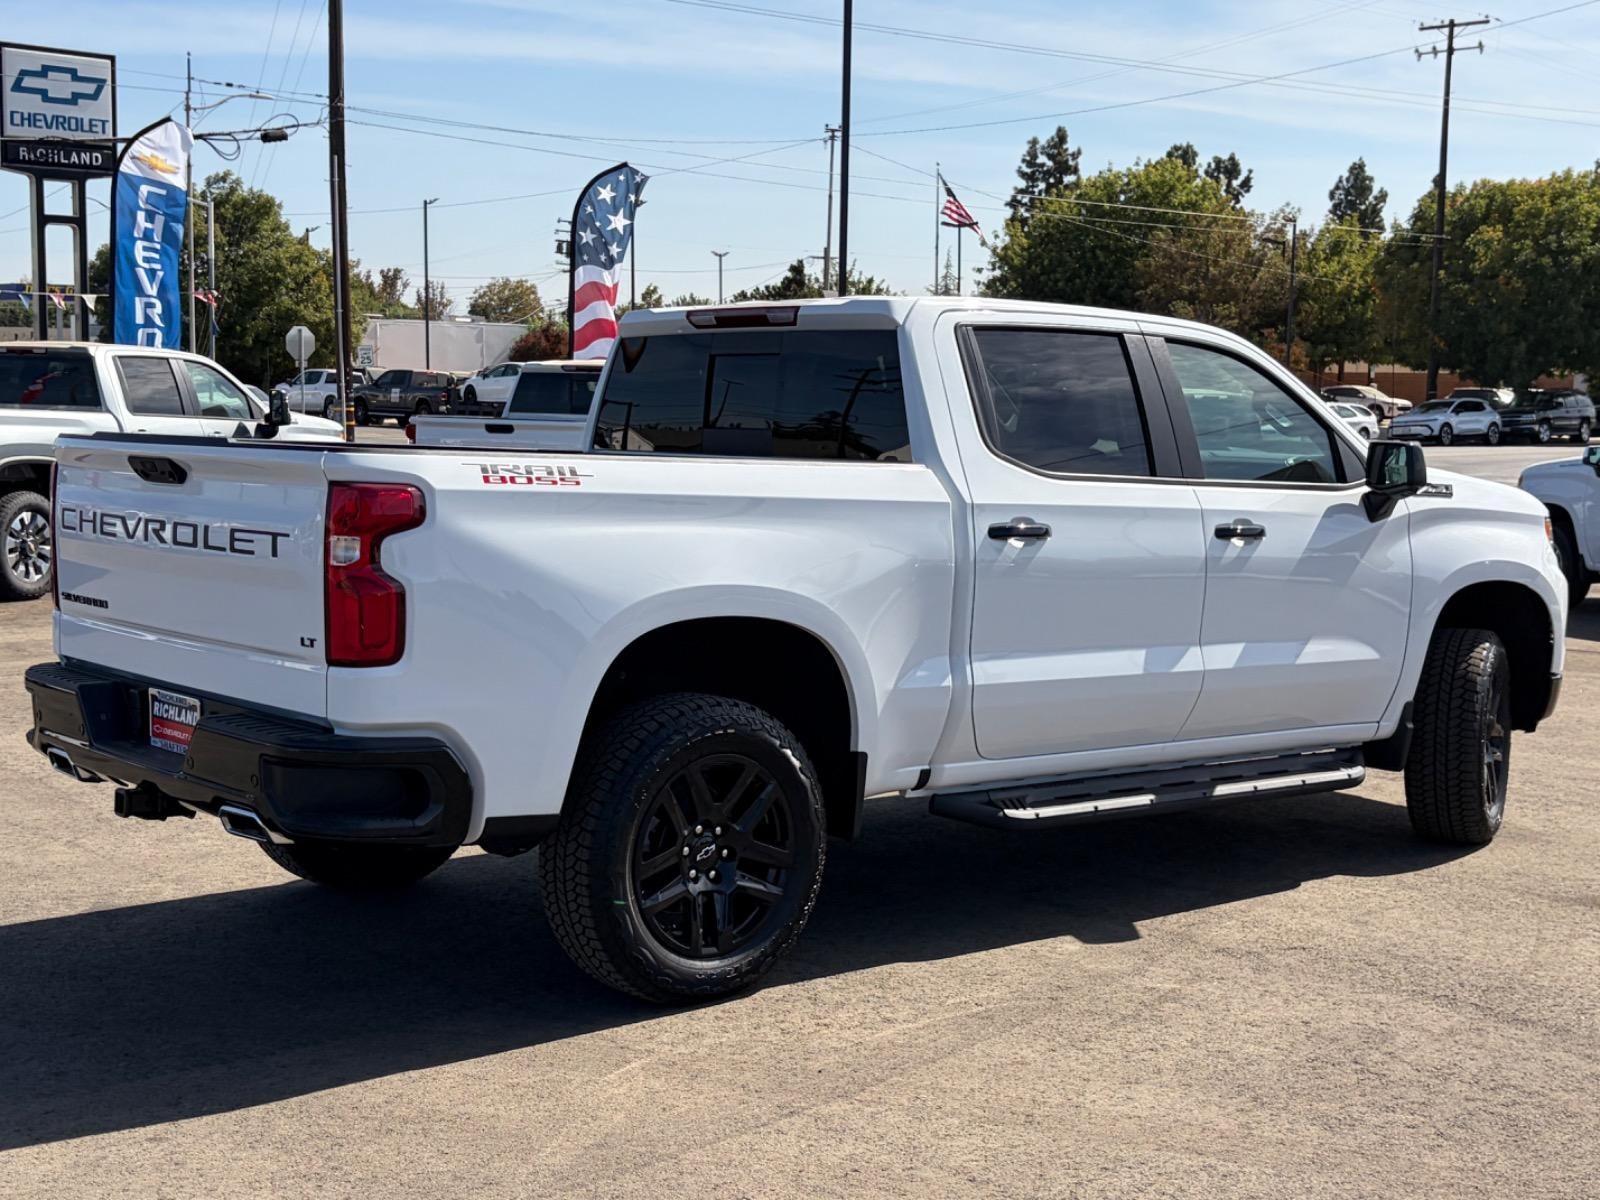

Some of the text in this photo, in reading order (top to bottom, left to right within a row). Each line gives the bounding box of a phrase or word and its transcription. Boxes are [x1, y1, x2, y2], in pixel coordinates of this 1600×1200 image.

[9, 110, 109, 135] CHEVROLET
[360, 355, 372, 365] 25
[461, 463, 594, 478] TRAIL
[482, 475, 581, 486] BOSS
[62, 507, 290, 558] CHEVROLET
[300, 636, 317, 649] LT
[153, 700, 198, 726] RICHLAND
